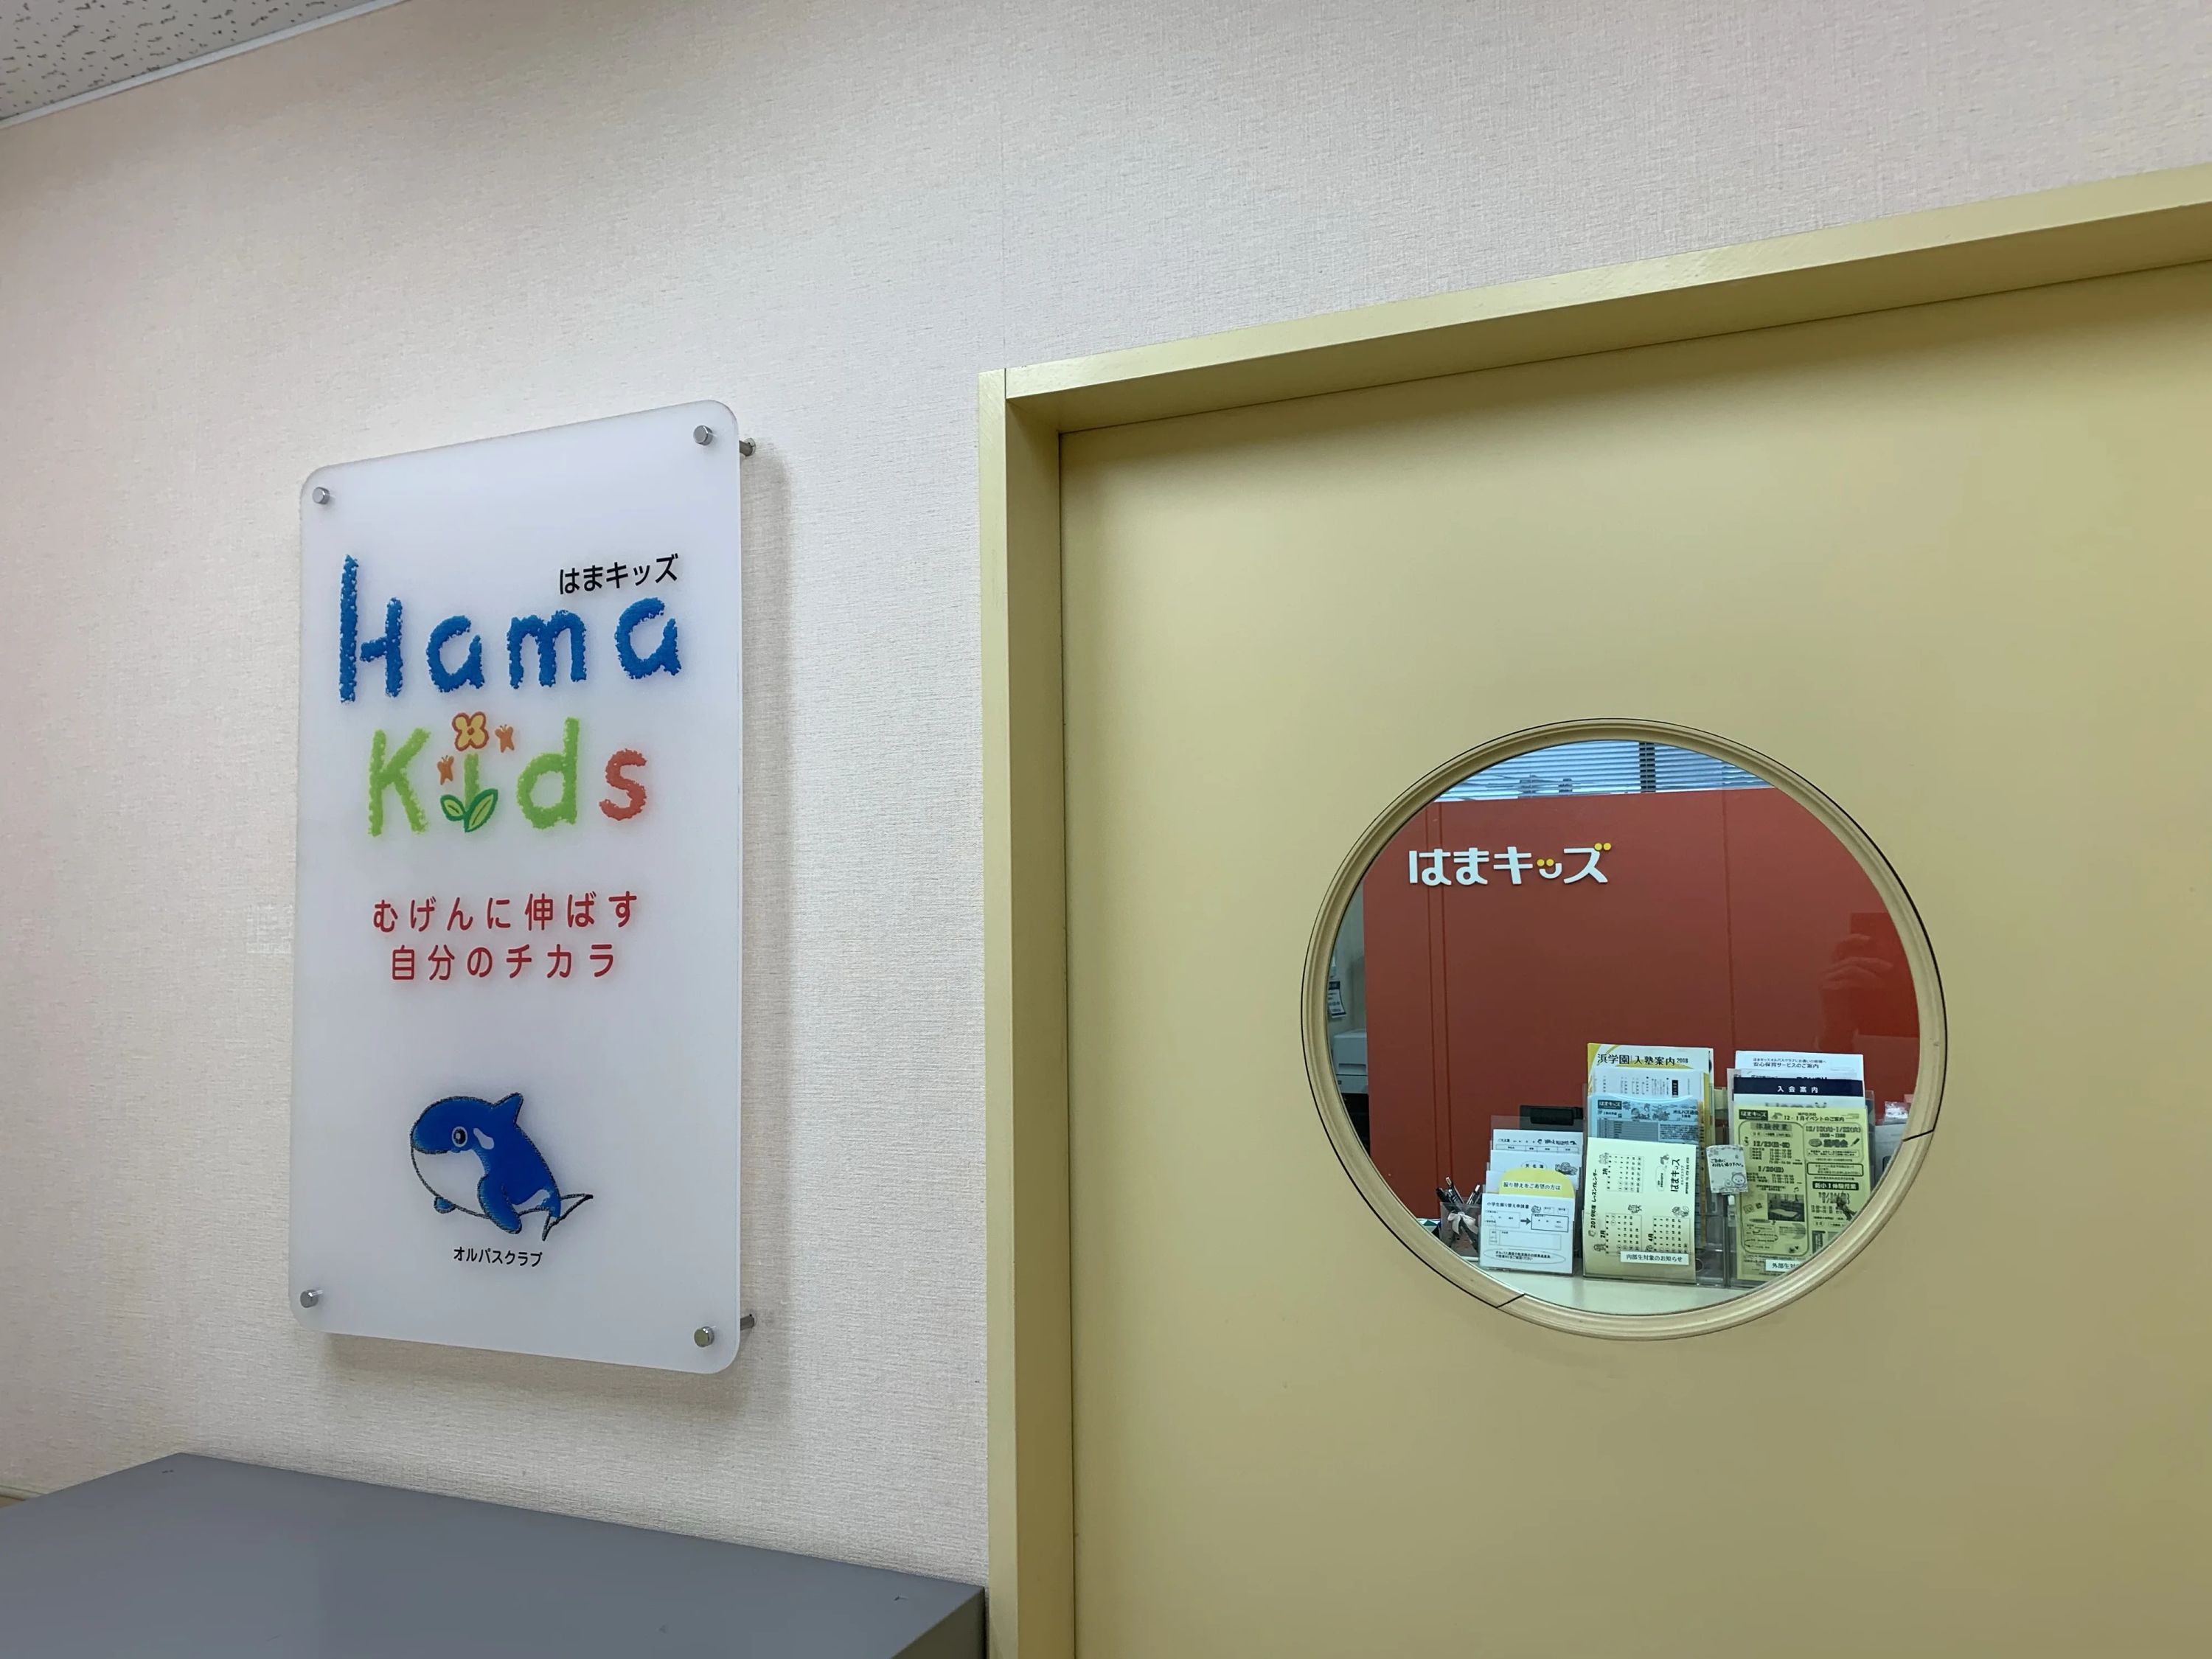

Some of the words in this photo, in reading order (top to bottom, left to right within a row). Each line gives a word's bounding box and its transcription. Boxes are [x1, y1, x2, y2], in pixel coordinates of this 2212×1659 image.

[559, 554, 679, 594] はまキッズ
[338, 554, 683, 705] Hama
[367, 714, 648, 838] Kids
[1409, 843, 1612, 886] はまキッズ
[372, 890, 638, 933] むげんに伸ばす
[391, 943, 616, 981] 自分のチカラ
[1597, 1054, 1630, 1066] 浜学園
[1634, 1055, 1675, 1066] 入塾案内
[1777, 1085, 1819, 1094] 入会案内
[1503, 1181, 1561, 1191] 振り替えをご希望の方は
[453, 1245, 543, 1267] オルパスクラブ
[1626, 1254, 1683, 1263] 内部生対象のお知らせ
